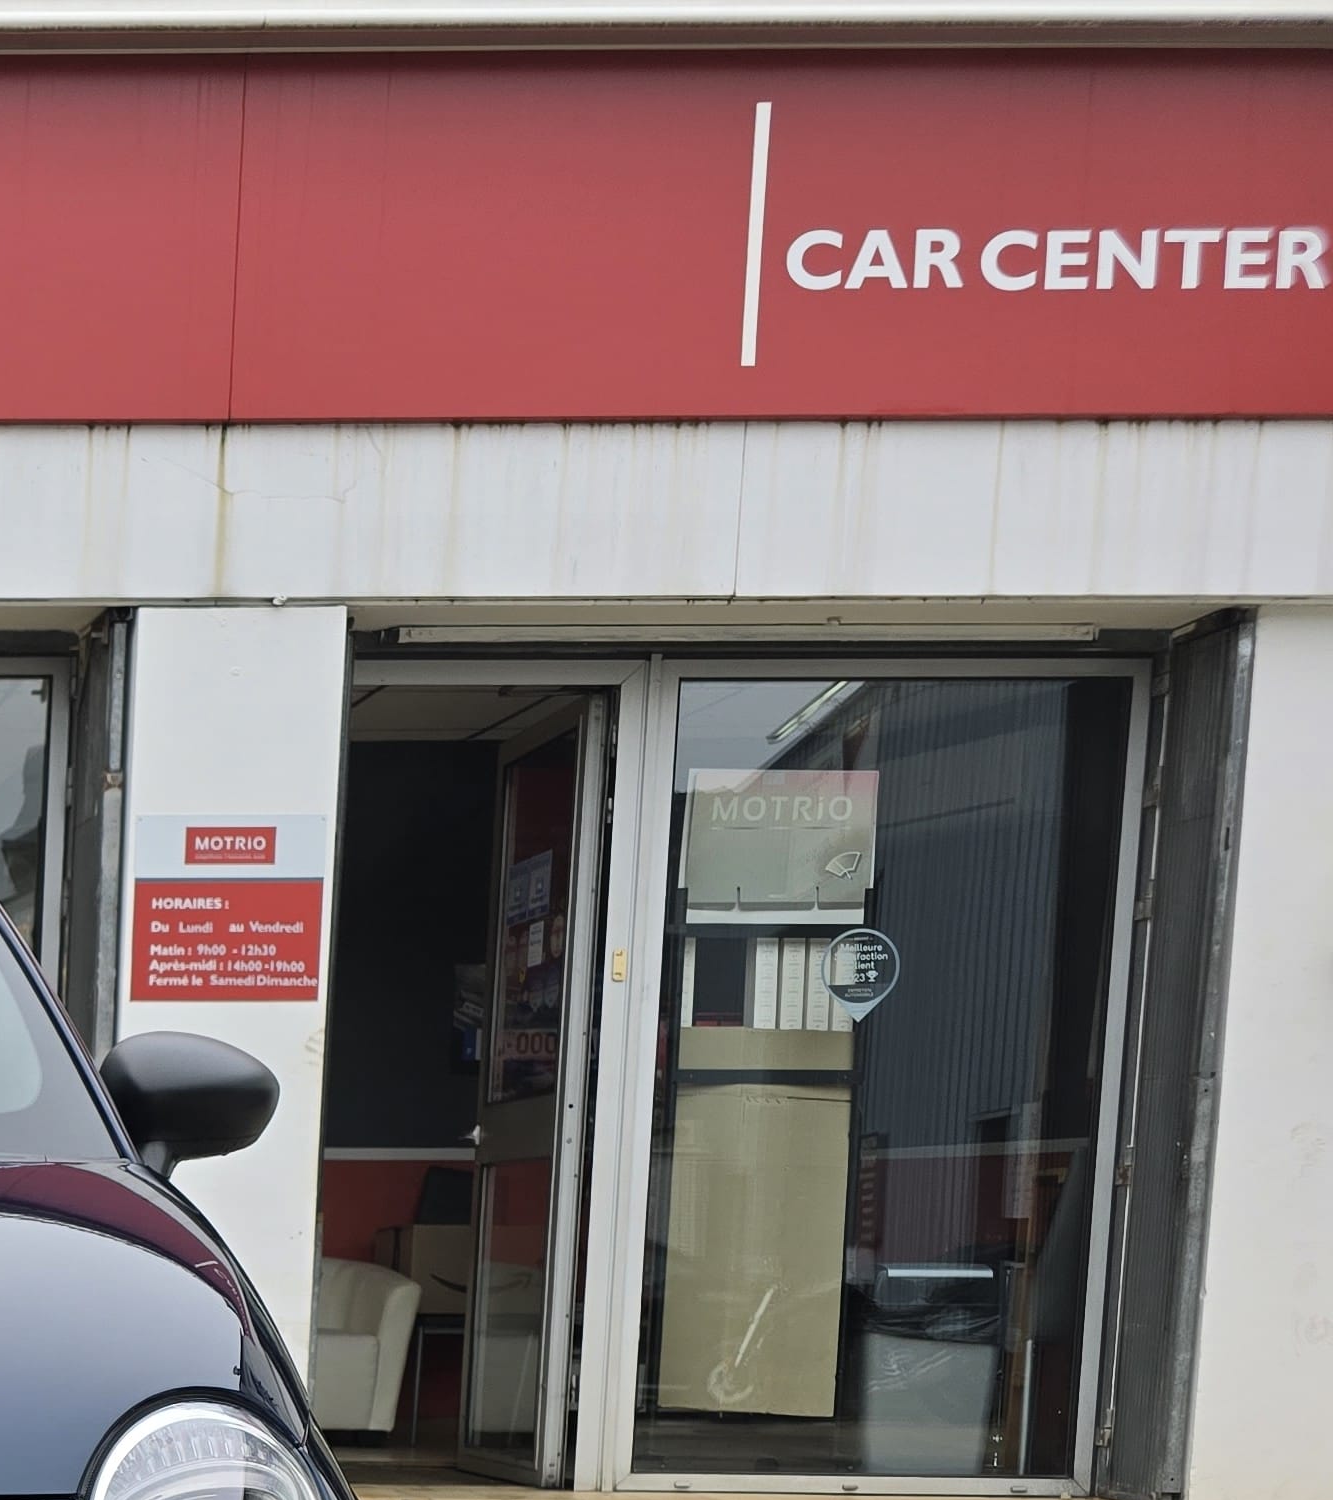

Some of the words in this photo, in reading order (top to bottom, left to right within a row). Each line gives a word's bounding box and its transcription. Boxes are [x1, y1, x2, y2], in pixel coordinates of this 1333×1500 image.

[786, 228, 964, 291] CAR
[980, 227, 1328, 291] CENTER
[151, 897, 222, 910] HORAIRES
[151, 920, 170, 933] Du
[178, 921, 213, 933] Lundi
[229, 923, 244, 933] au
[249, 920, 304, 933] Vendredi
[197, 944, 226, 955] 9h00
[240, 944, 276, 956] 12h30
[227, 960, 262, 972] 14h00
[851, 961, 875, 970] lient
[149, 974, 189, 987] Fermé
[191, 975, 203, 987] le
[209, 974, 255, 987] Samedi
[256, 974, 318, 987] Dimanche
